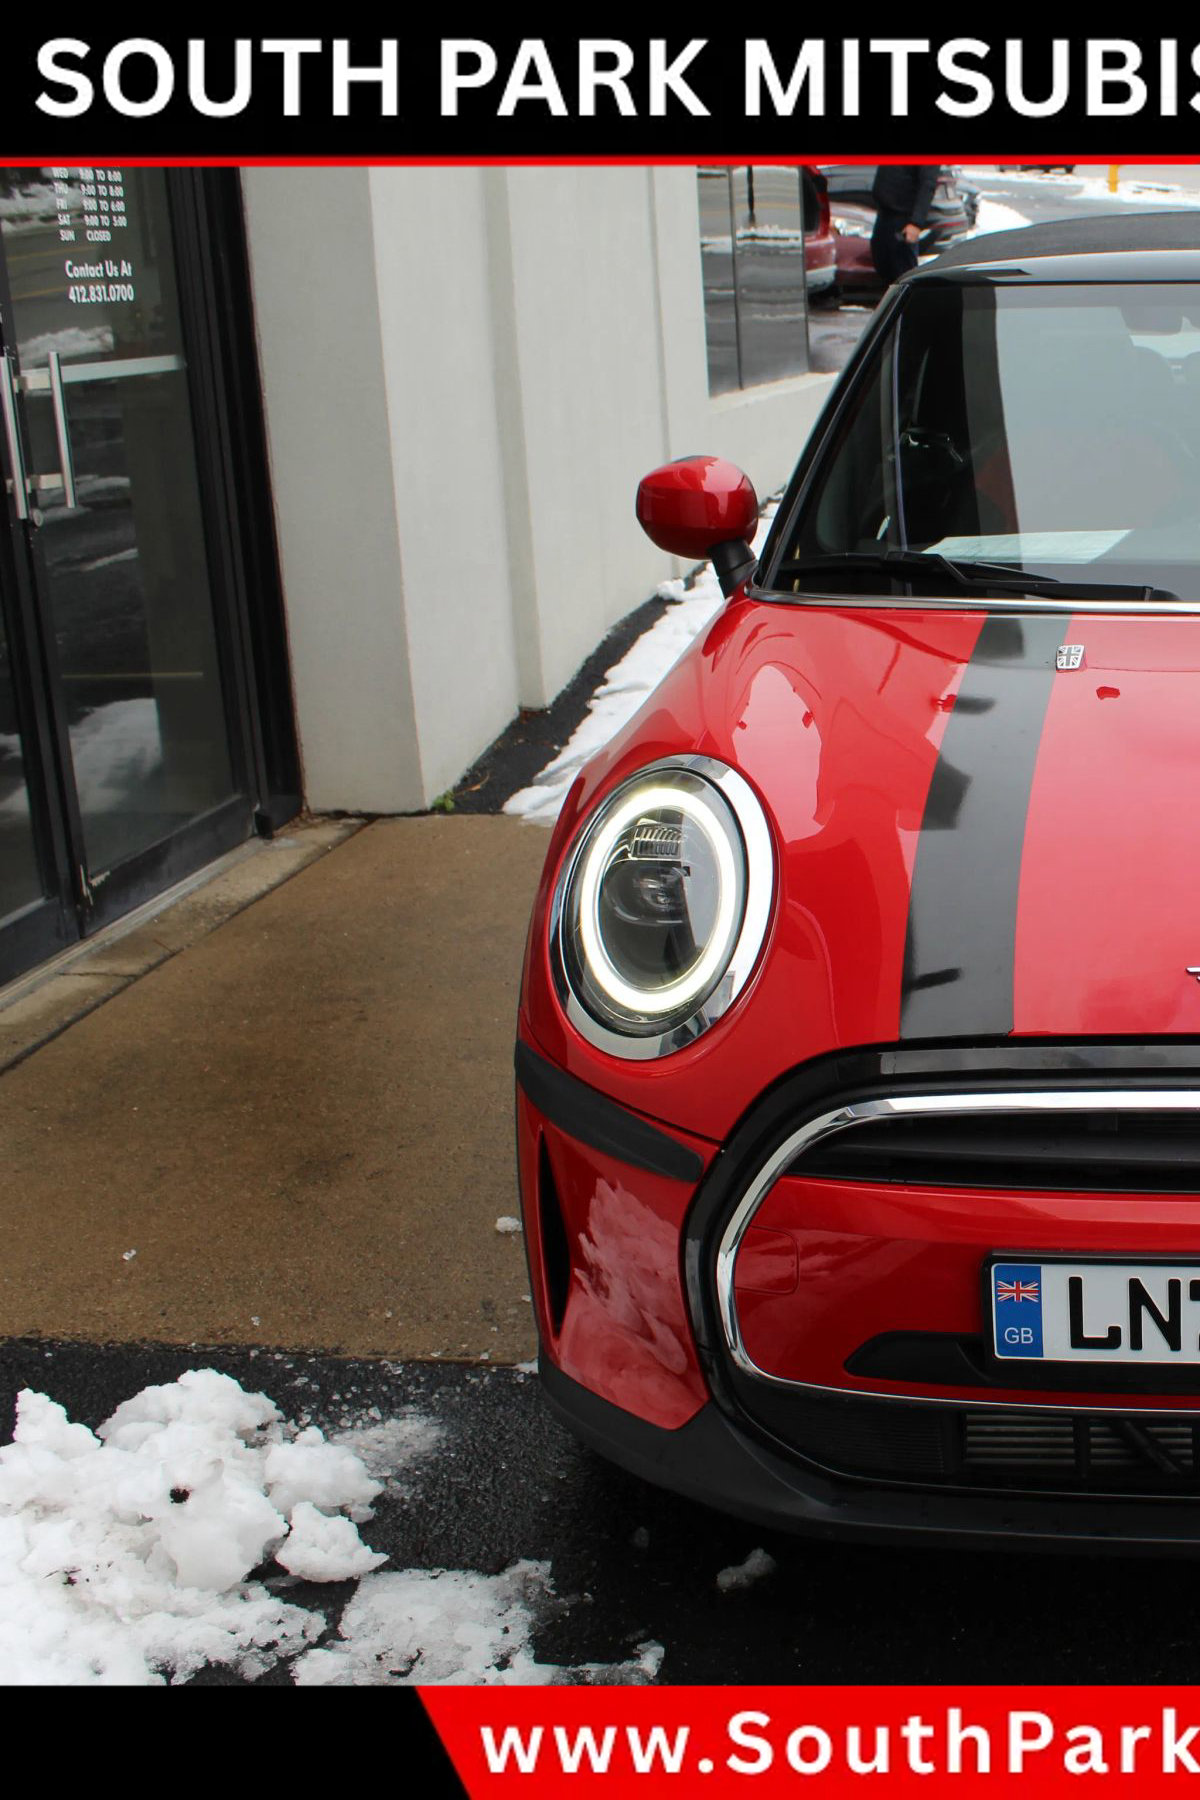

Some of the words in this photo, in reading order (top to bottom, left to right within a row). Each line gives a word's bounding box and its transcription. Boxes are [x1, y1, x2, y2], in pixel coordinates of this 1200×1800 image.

[97, 184, 107, 197] TO
[99, 200, 109, 212] TO
[57, 213, 71, 226] SAT
[100, 215, 110, 226] TO
[60, 229, 76, 241] SUN
[86, 230, 112, 241] CLOSED
[65, 260, 104, 278] Contact
[105, 260, 119, 277] Us
[120, 260, 132, 277] At
[69, 283, 134, 303] 412.831.0700
[1004, 1327, 1033, 1344] GB
